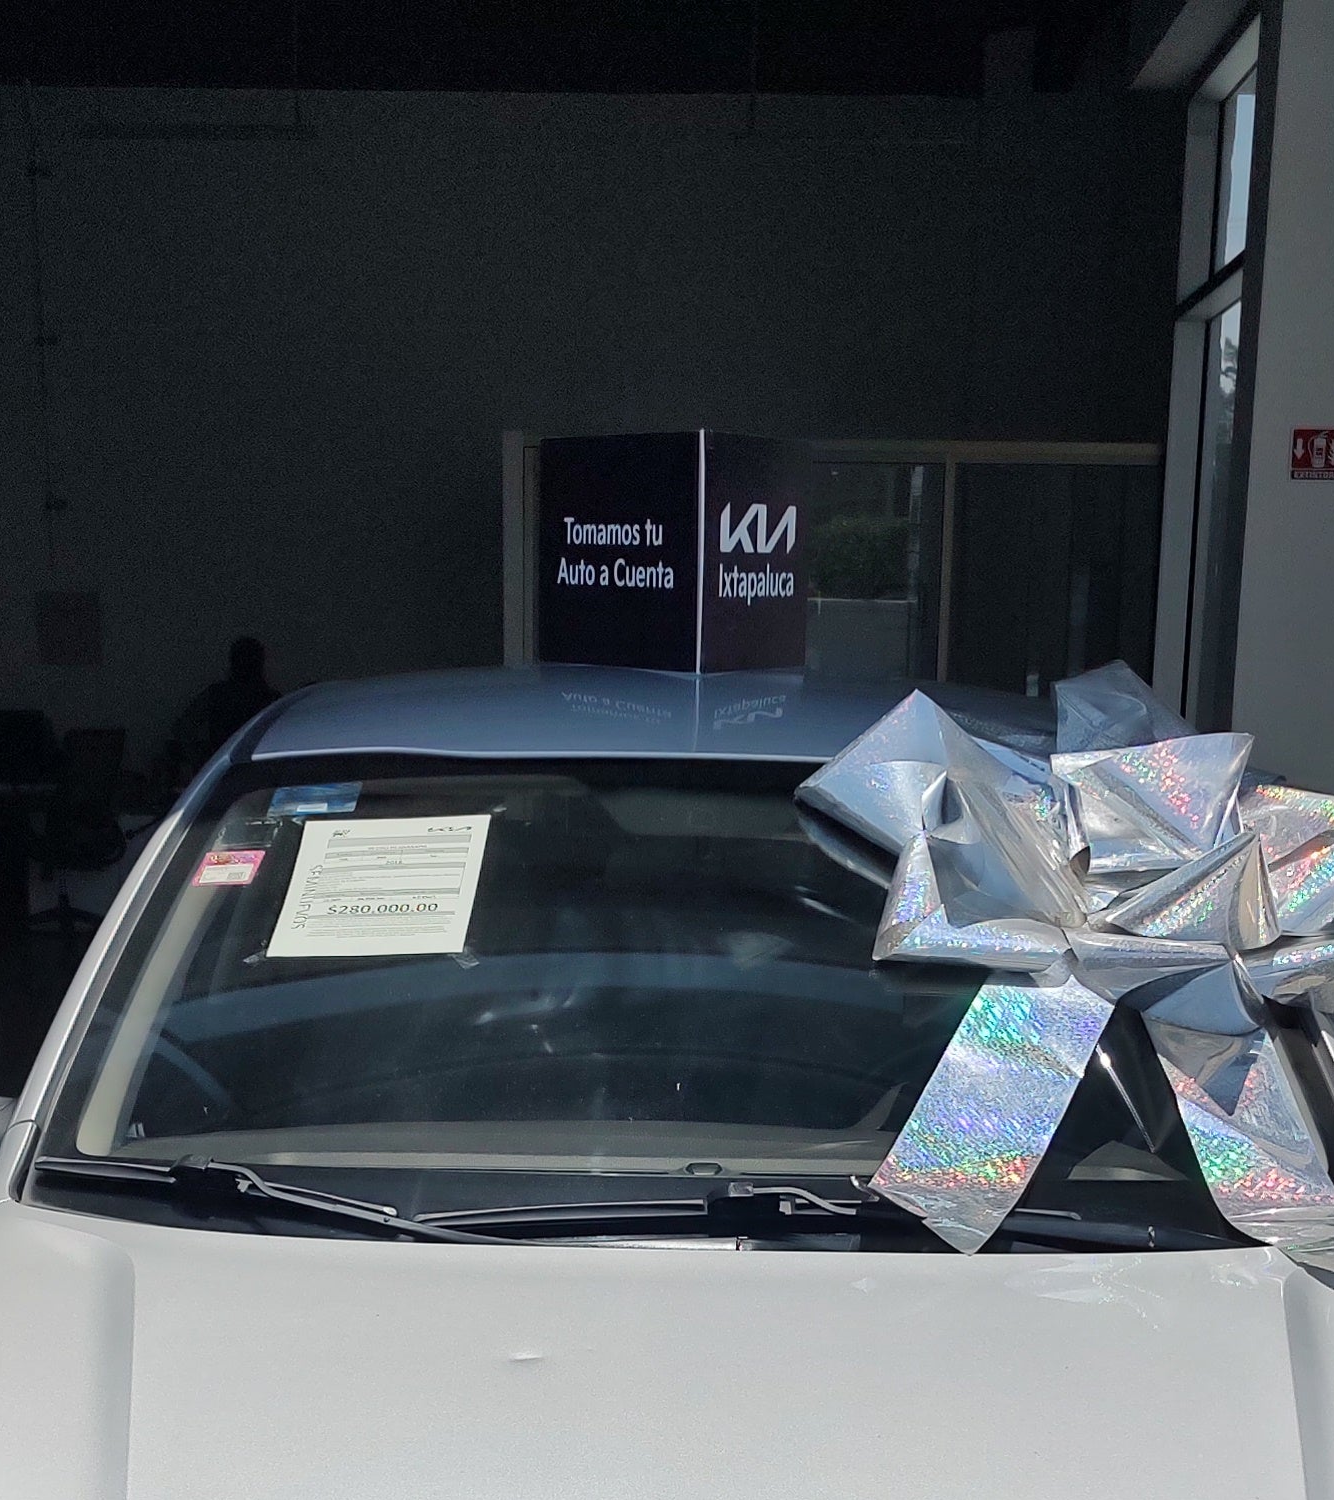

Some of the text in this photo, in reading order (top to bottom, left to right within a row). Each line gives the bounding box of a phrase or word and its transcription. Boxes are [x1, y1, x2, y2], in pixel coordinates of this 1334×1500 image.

[564, 517, 663, 546] Tomamos tu
[719, 501, 797, 554] KIA
[557, 557, 674, 589] Auto a Cuenta
[719, 563, 794, 606] Ixtapaluca
